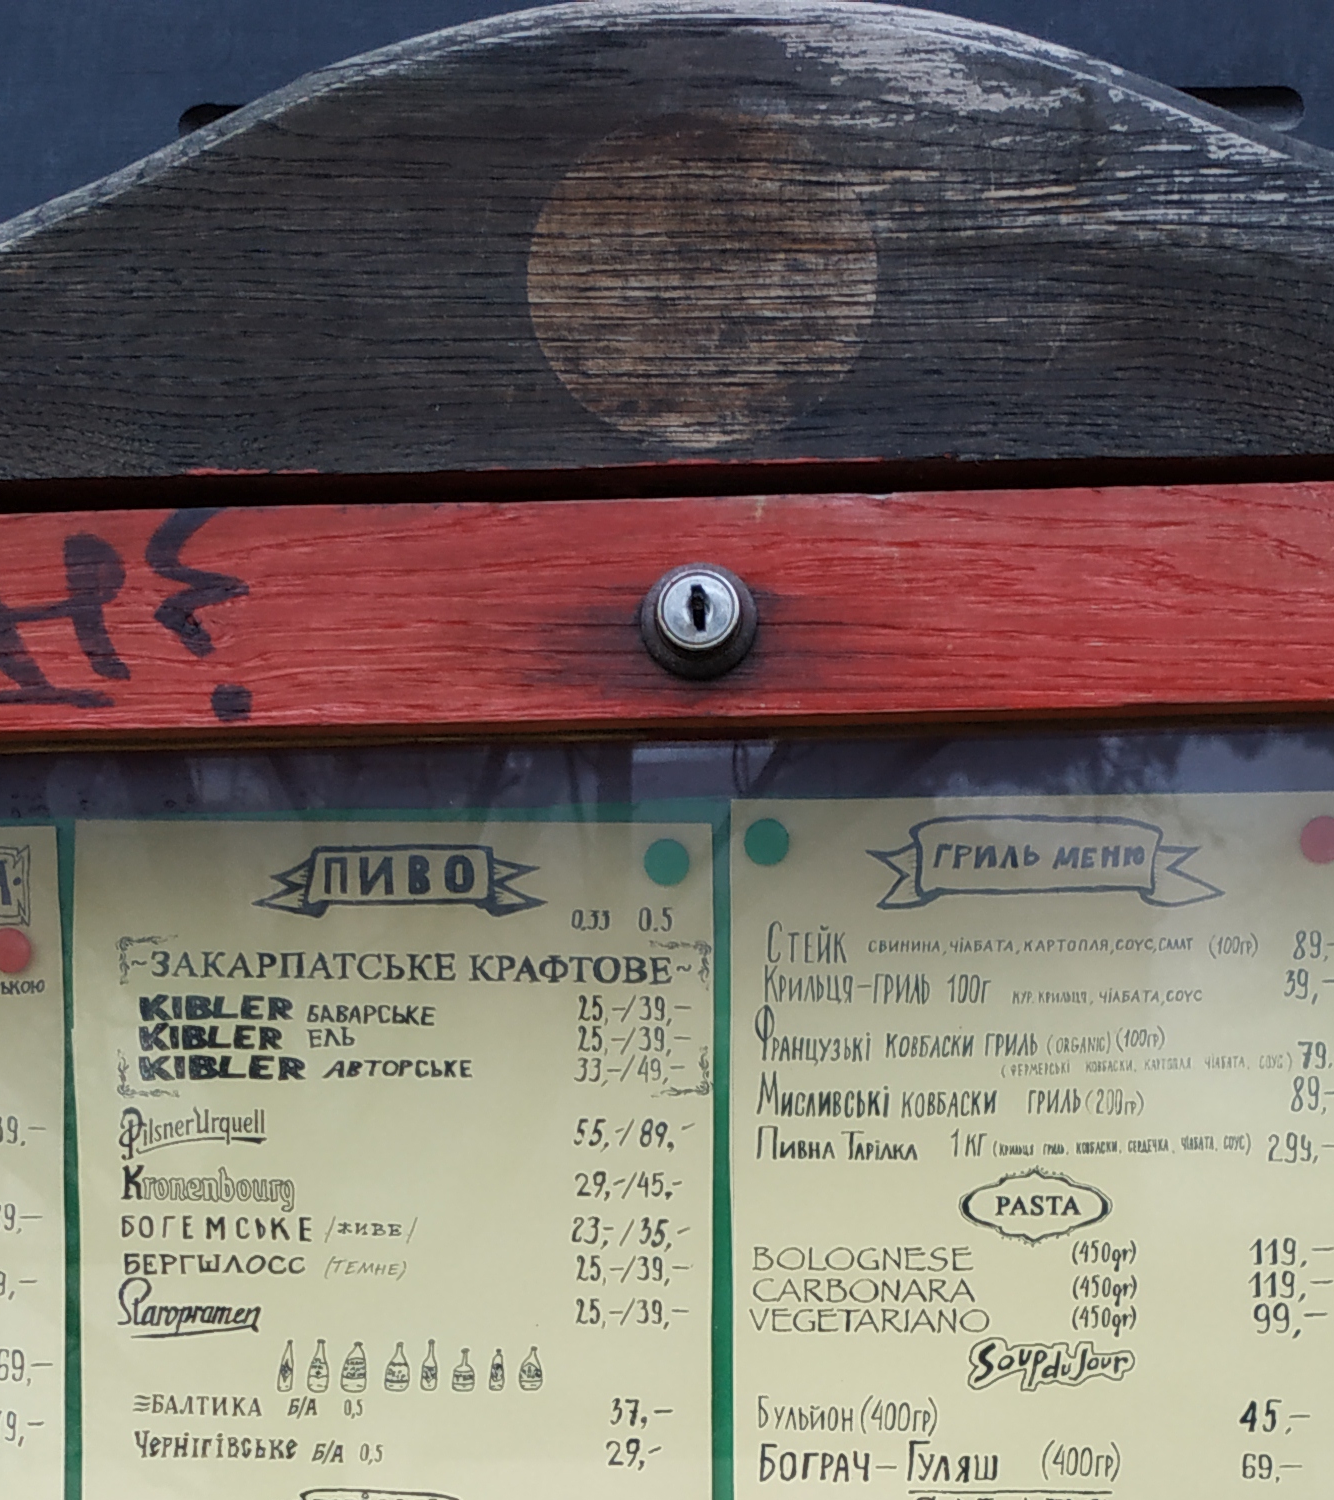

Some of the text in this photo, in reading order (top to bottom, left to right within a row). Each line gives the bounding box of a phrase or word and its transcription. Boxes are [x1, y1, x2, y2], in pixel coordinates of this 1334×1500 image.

[933, 843, 1145, 870] ГРИЛЬ МЕНЮ
[324, 854, 475, 896] ПИВО
[469, 955, 672, 985] КРАФТОВЕ
[139, 994, 435, 1026] KIBLER БАВАРСЬКЕ
[139, 1022, 282, 1051] KIBLER
[139, 1055, 472, 1081] KIBLER АВТОРСЬКЕ
[121, 1164, 295, 1213] Kronenbourg
[995, 1195, 1081, 1216] PASTA
[752, 1246, 973, 1272] BOLOGNESE
[753, 1278, 975, 1303] CARBONARA
[749, 1308, 990, 1333] VEGETARIANO
